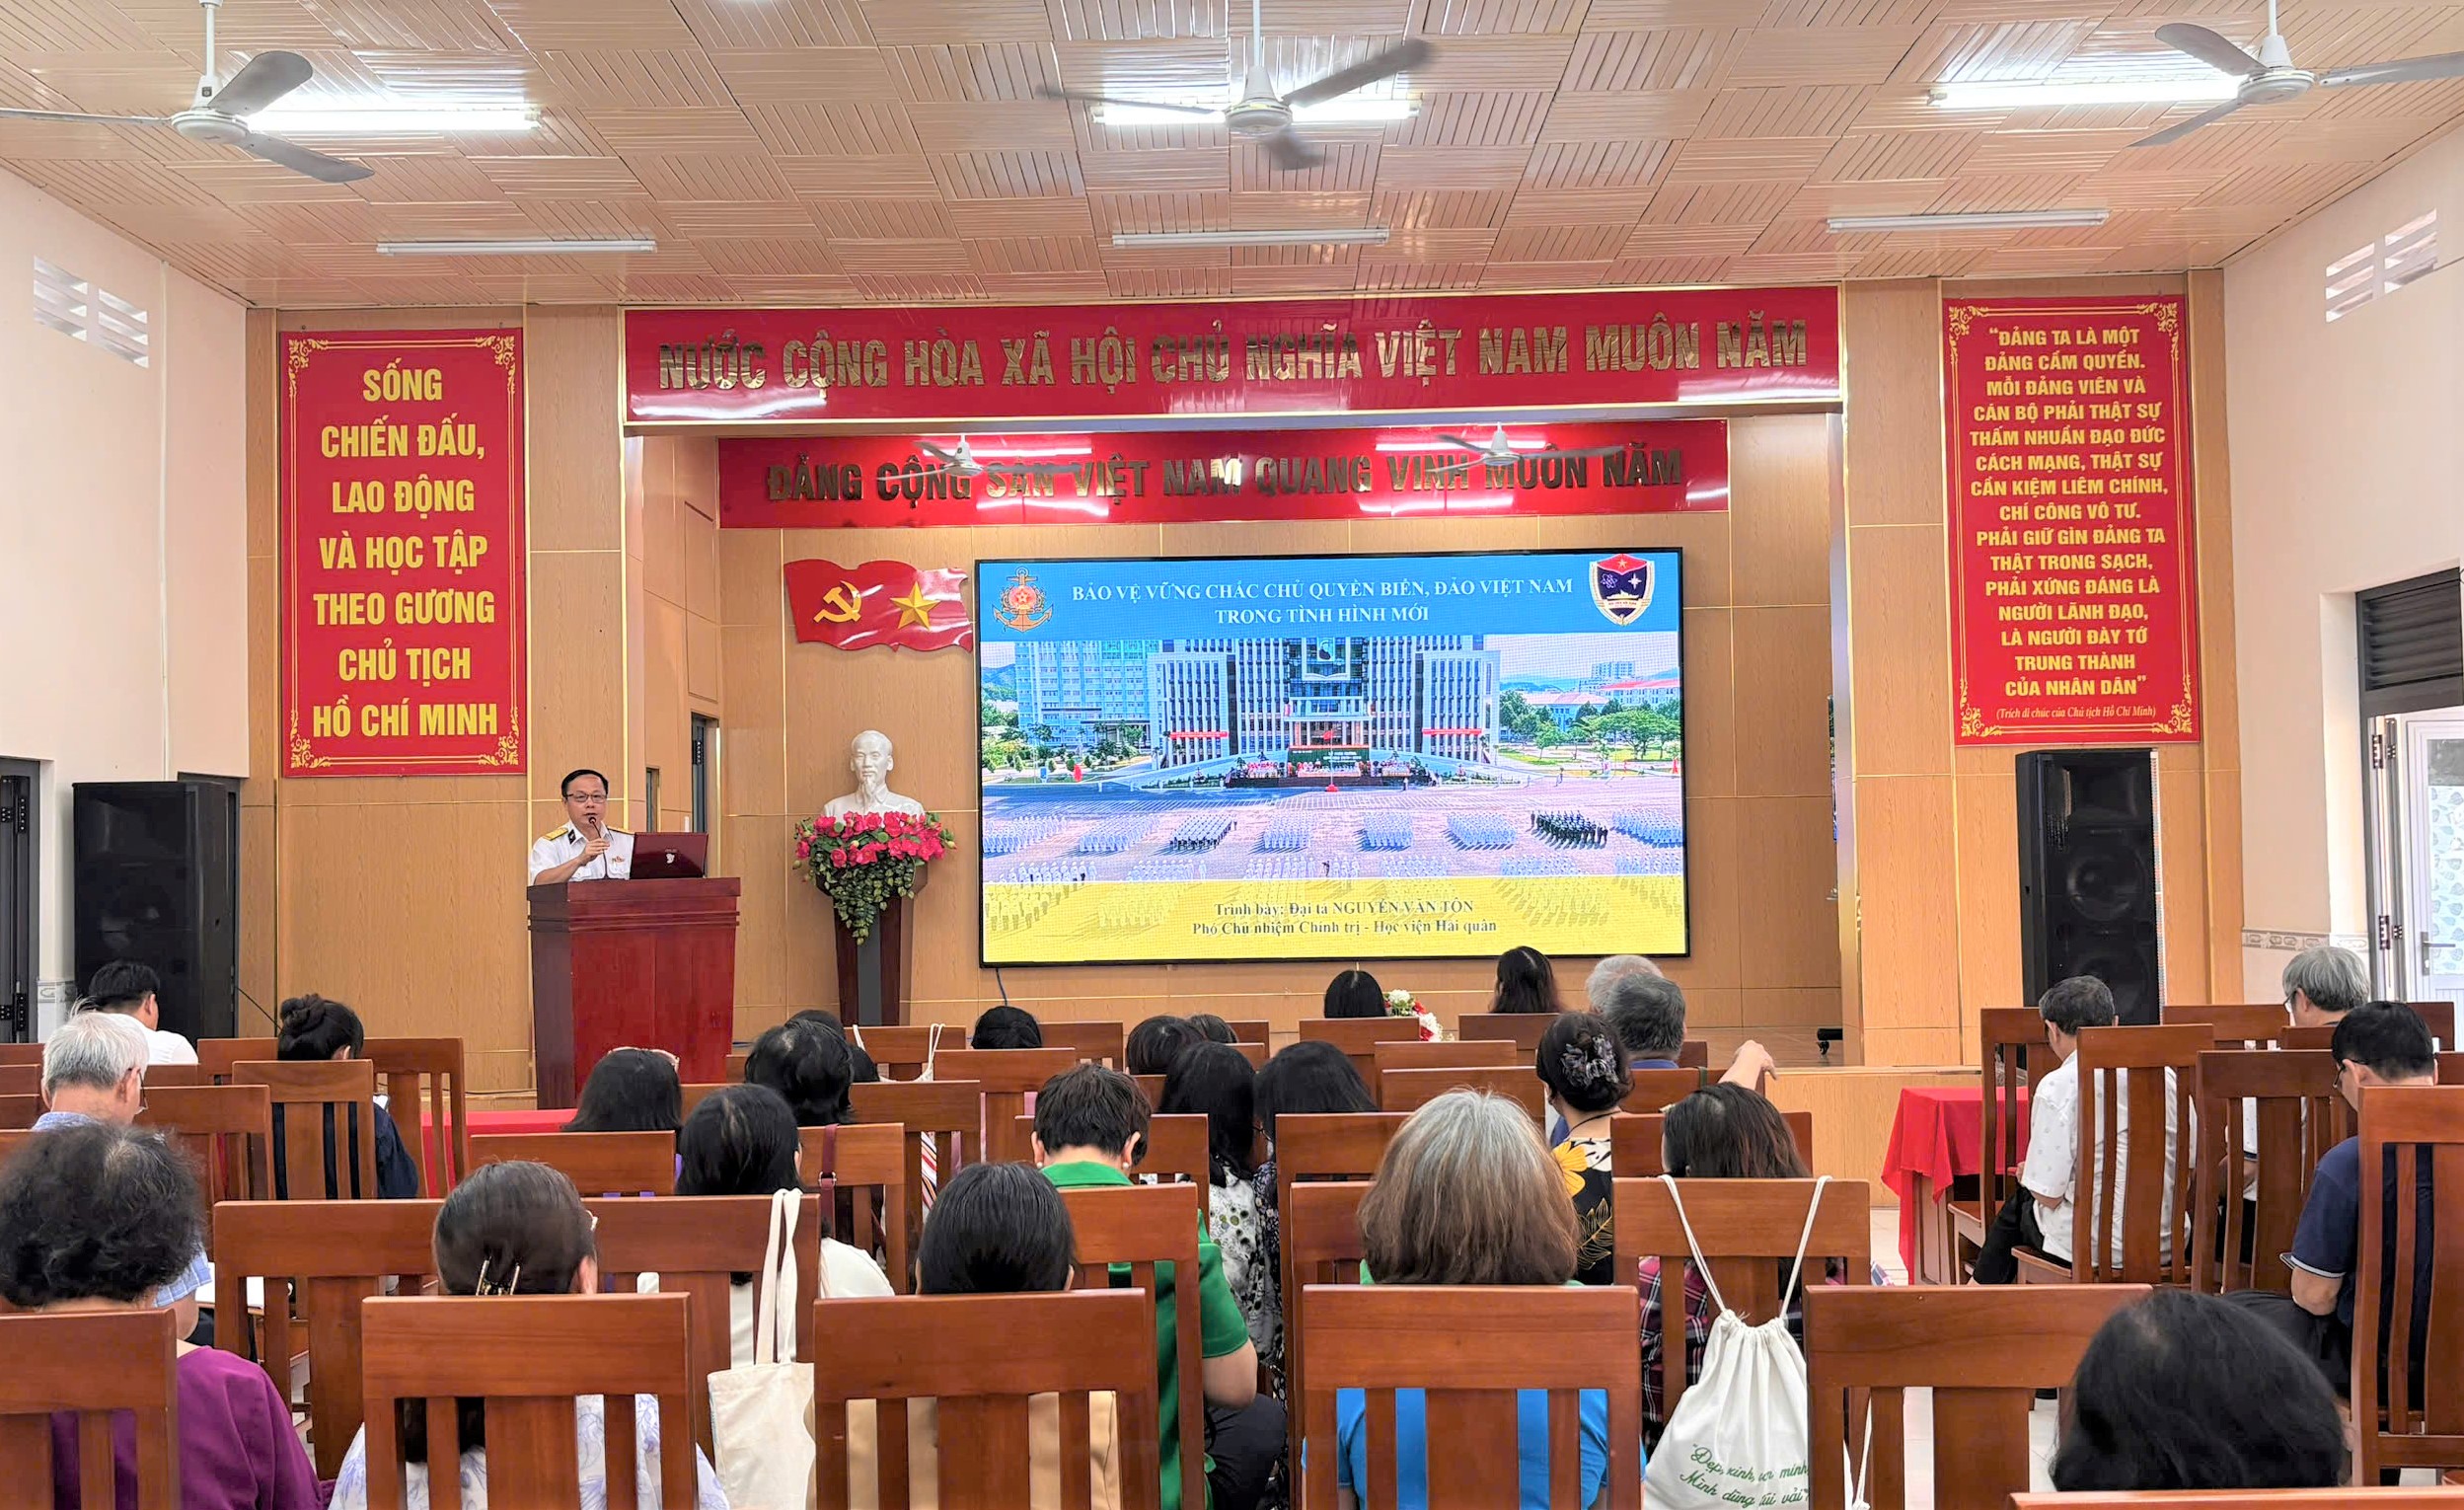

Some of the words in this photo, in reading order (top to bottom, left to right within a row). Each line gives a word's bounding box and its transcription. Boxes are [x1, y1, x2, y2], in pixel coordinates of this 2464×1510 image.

[2052, 331, 2070, 345] TA
[2076, 328, 2097, 345] LÀ
[2103, 327, 2139, 346] MỘT
[659, 328, 766, 390] NƯỚC
[784, 331, 888, 399] CỘNG
[904, 327, 985, 387] HÒA
[1001, 330, 1055, 387] XÃ
[1071, 327, 1137, 393] HỘI
[1151, 320, 1229, 383] CHỦ
[1245, 324, 1362, 381] NGHĨA
[1376, 320, 1462, 387] VIỆT
[1478, 326, 1568, 375] NAM
[1585, 312, 1699, 371] MUÔN
[1716, 310, 1806, 368] NĂM
[1985, 352, 2033, 371] ĐẢNG
[362, 357, 442, 402] SỐNG
[1986, 376, 2020, 396] MỖI
[2026, 376, 2072, 395] ĐẢNG
[2078, 377, 2118, 394] VIÊN
[2124, 376, 2146, 394] VÀ
[1974, 404, 2010, 420] CÁN
[2015, 403, 2038, 423] BỘ
[2044, 401, 2084, 419] PHẢI
[2089, 402, 2131, 422] THẬT
[2137, 402, 2162, 420] SỰ
[321, 415, 409, 458] CHIẾN
[417, 413, 485, 459] ĐẤU,
[1970, 426, 2019, 446] THẤM
[2090, 428, 2125, 446] ĐẠO
[2130, 426, 2165, 443] ĐỨC
[1976, 453, 2022, 471] CÁCH
[2028, 455, 2085, 473] MẠNG,
[2090, 451, 2132, 472] THẬT
[2138, 452, 2163, 471] SỰ
[768, 452, 862, 501] ĐẢNG
[876, 454, 971, 508] CỘNG
[1074, 454, 1149, 505] VIỆT
[1162, 456, 1241, 495] NAM
[1255, 456, 1372, 493] QUANG
[1387, 455, 1468, 491] VINH
[1486, 444, 1587, 490] MUÔN
[1603, 443, 1680, 487] NĂM
[333, 481, 384, 513] LAO
[394, 474, 474, 519] ĐỘNG
[1971, 477, 2006, 495] CẦN
[2012, 478, 2056, 497] KIỆM
[2062, 477, 2103, 493] LIÊM
[2109, 476, 2168, 495] CHÍNH,
[2000, 503, 2028, 521] CHÍ
[2035, 502, 2082, 520] CÔNG
[2087, 501, 2109, 519] VÔ
[2115, 502, 2141, 518] TƯ.
[1977, 526, 2017, 546] PHẢI
[2023, 527, 2053, 545] GIỮ
[2057, 527, 2087, 545] GÌN
[2093, 524, 2140, 544] ĐẢNG
[2146, 528, 2165, 543] TA
[319, 530, 356, 569] VÀ
[366, 537, 423, 574] HỌC
[432, 529, 487, 574] TẬP
[1990, 554, 2033, 573] THẬT
[2038, 554, 2095, 569] TRONG
[2102, 554, 2153, 572] SẠCH,
[1116, 583, 1141, 603] VỆ
[1264, 579, 1304, 598] CHỦ
[1480, 578, 1524, 598] VIỆT
[1530, 578, 1573, 593] NAM
[1986, 576, 2026, 596] PHẢI
[2033, 577, 2079, 595] XỨNG
[2085, 576, 2132, 594] ĐÁNG
[2138, 575, 2160, 593] LÀ
[314, 592, 385, 625] THEO
[396, 589, 494, 624] GƯƠNG
[1215, 609, 1281, 624] TRONG
[1287, 605, 1331, 623] TÌNH
[1338, 604, 1385, 622] HÌNH
[1391, 603, 1428, 621] MỚI
[1999, 602, 2052, 621] NGƯỜI
[2058, 602, 2103, 620] LÃNH
[2109, 604, 2148, 622] ĐẠO,
[2001, 628, 2023, 645] LÀ
[2028, 627, 2081, 645] NGƯỜI
[2087, 629, 2121, 644] ĐÀY
[2126, 626, 2148, 643] TỚ
[338, 638, 397, 681] CHỦ
[406, 648, 471, 686] TỊCH
[2015, 655, 2072, 671] TRUNG
[2078, 651, 2135, 669] THÀNH
[2005, 676, 2041, 696] CỦA
[2047, 679, 2095, 695] NHÂN
[313, 694, 351, 737] HỒ
[361, 698, 410, 737] CHÍ
[419, 704, 497, 736] MINH
